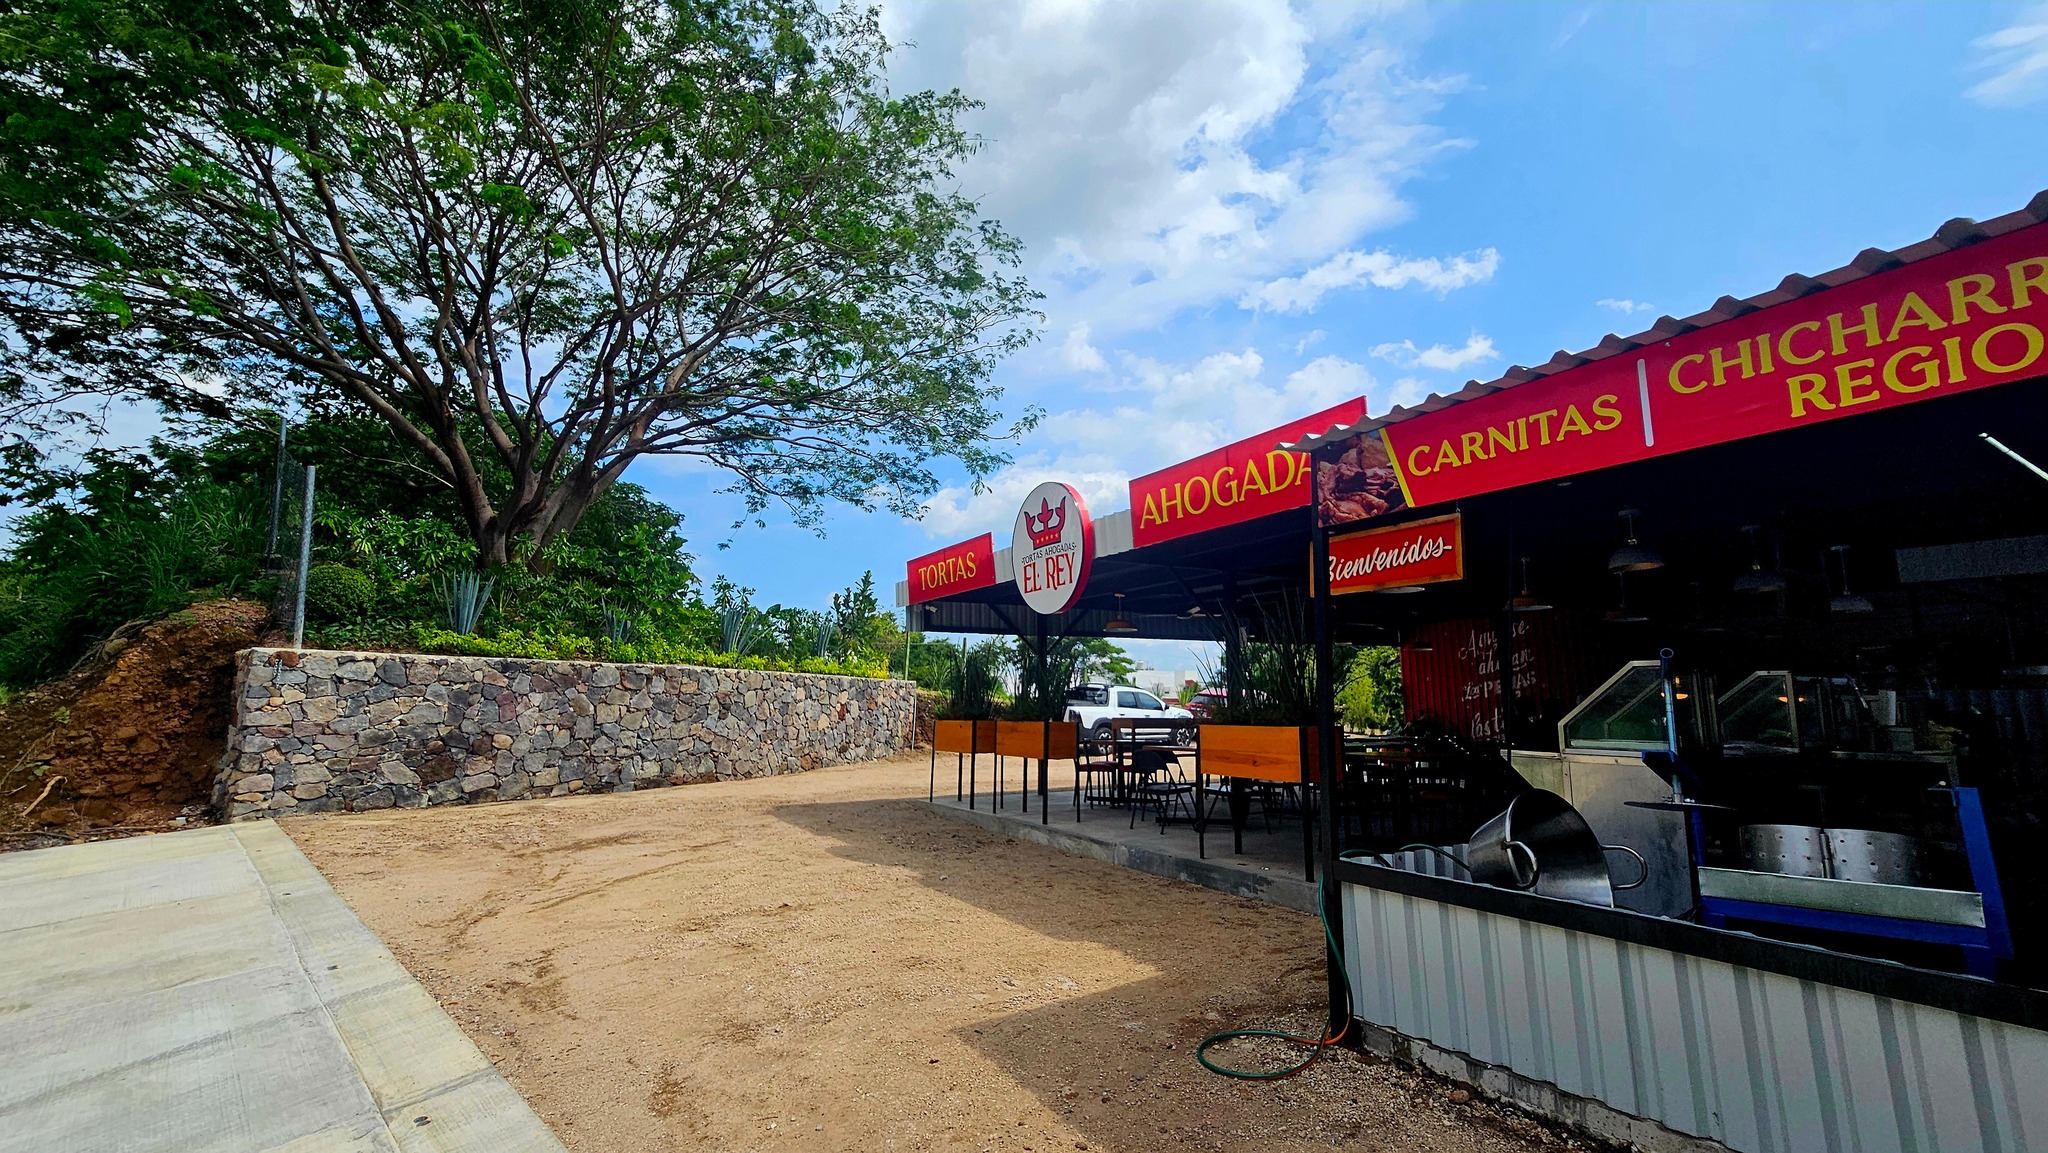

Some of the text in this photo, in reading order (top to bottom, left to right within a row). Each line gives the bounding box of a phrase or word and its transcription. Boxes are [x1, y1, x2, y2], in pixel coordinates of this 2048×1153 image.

[1785, 322, 2045, 418] REGIO
[1407, 394, 1623, 476] CARNITAS
[918, 551, 977, 591] TORTAS
[1022, 541, 1076, 565] TORTAS AHOGADAS
[1023, 551, 1075, 594] EL REY
